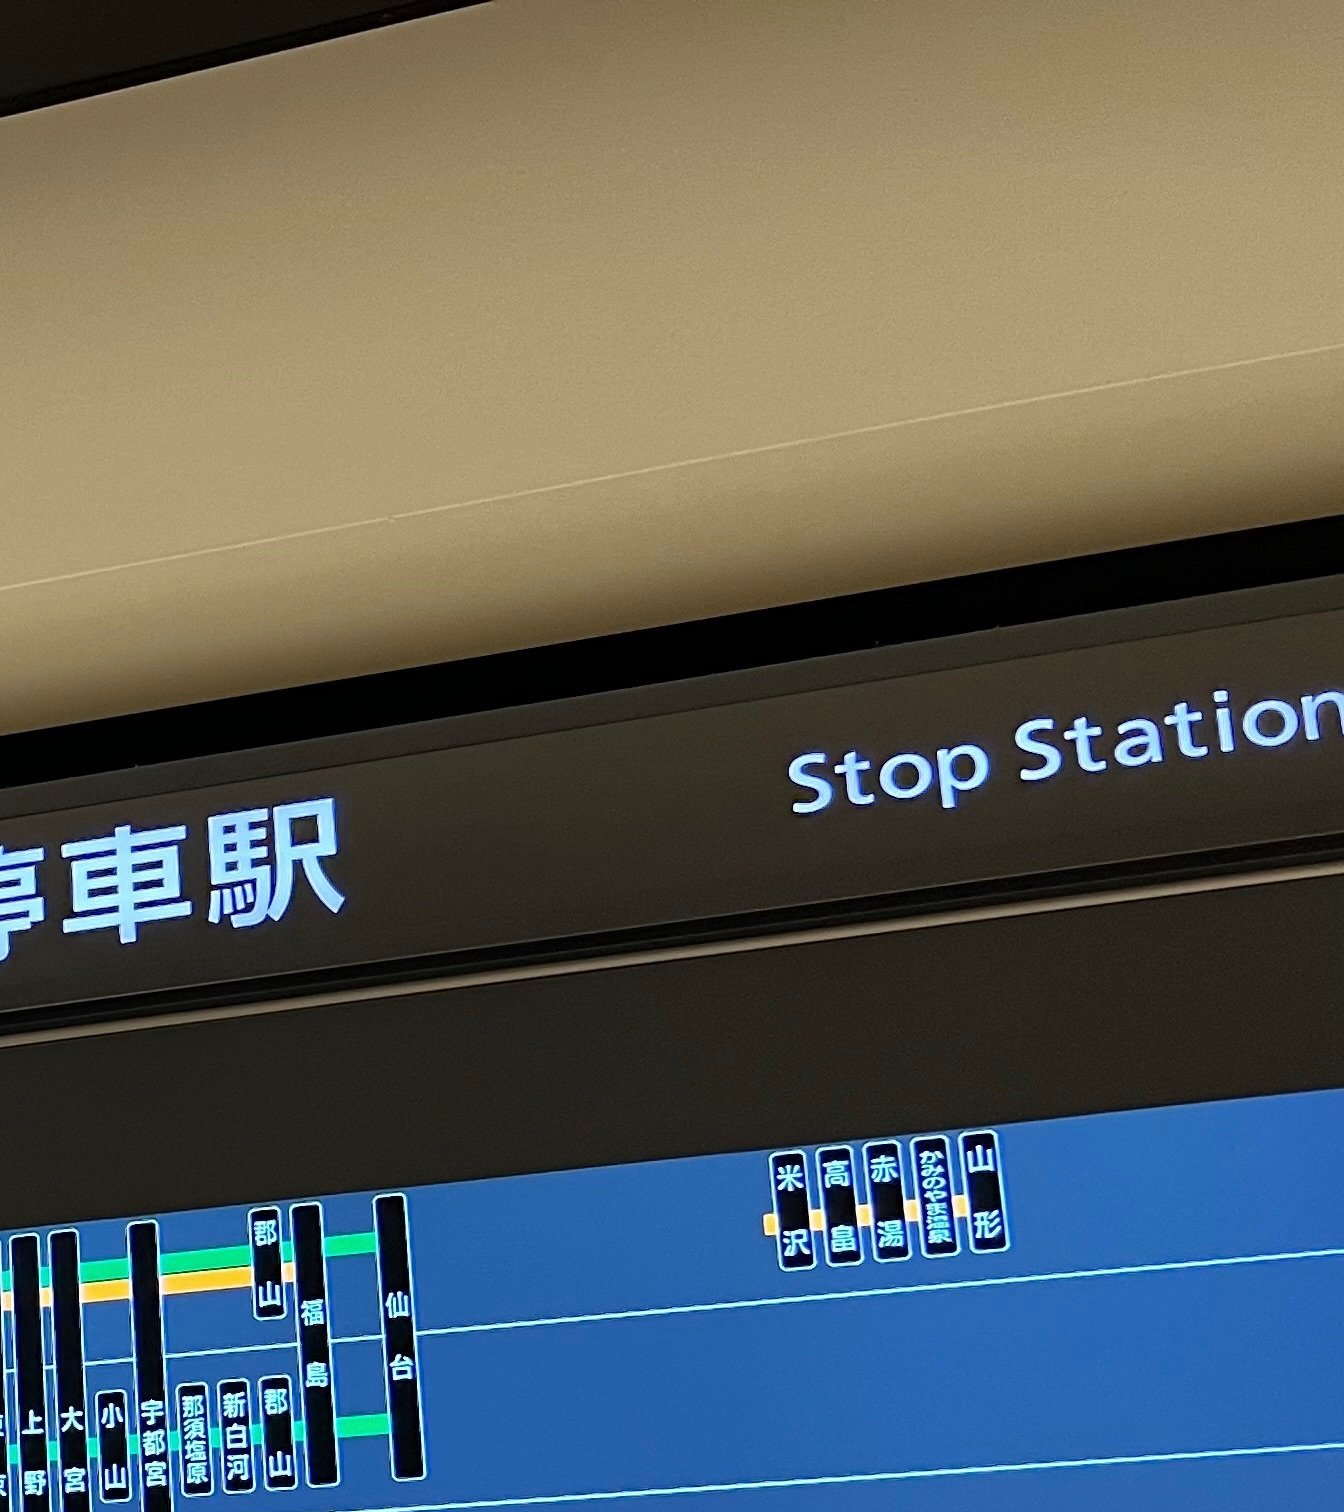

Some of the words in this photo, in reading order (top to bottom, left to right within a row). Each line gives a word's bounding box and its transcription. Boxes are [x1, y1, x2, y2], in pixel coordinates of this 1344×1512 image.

[788, 734, 990, 808] Stop
[776, 1163, 811, 1257] 米沢
[822, 1160, 857, 1253] 高畠
[870, 1154, 905, 1249] 赤湯
[919, 1149, 954, 1245] かみのやま温泉
[966, 1144, 1002, 1240] 山形
[254, 1218, 282, 1308] 郡山
[300, 1298, 329, 1388] 福島
[384, 1290, 414, 1382] 仙台
[20, 1407, 48, 1497] 上野
[59, 1404, 87, 1494] 大宮
[100, 1402, 129, 1490] 小山
[139, 1398, 168, 1488] 宇都宮
[181, 1394, 209, 1485] 那須塩原
[222, 1391, 251, 1482] 新白河
[264, 1388, 292, 1479] 郡山
